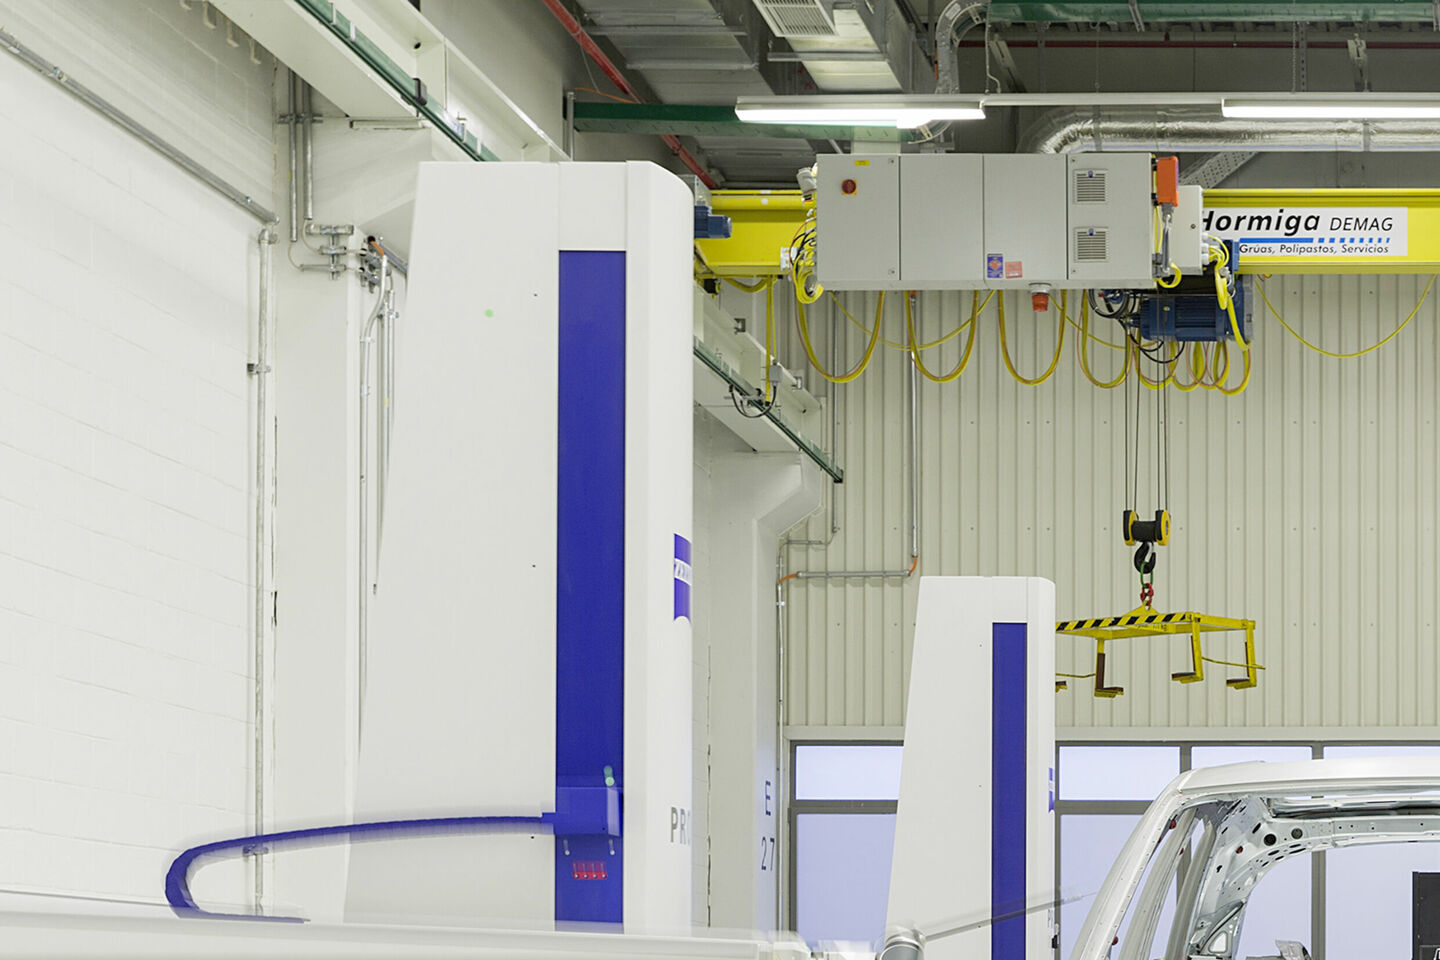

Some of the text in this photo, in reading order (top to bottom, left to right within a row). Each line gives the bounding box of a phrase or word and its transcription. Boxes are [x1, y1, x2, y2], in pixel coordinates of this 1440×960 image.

[1202, 208, 1394, 237] Hormiga DEMAG
[1239, 243, 1389, 257] Grúas, Polipastos, Servicios
[764, 780, 772, 816] E
[670, 806, 691, 846] PR
[761, 836, 776, 872] 27
